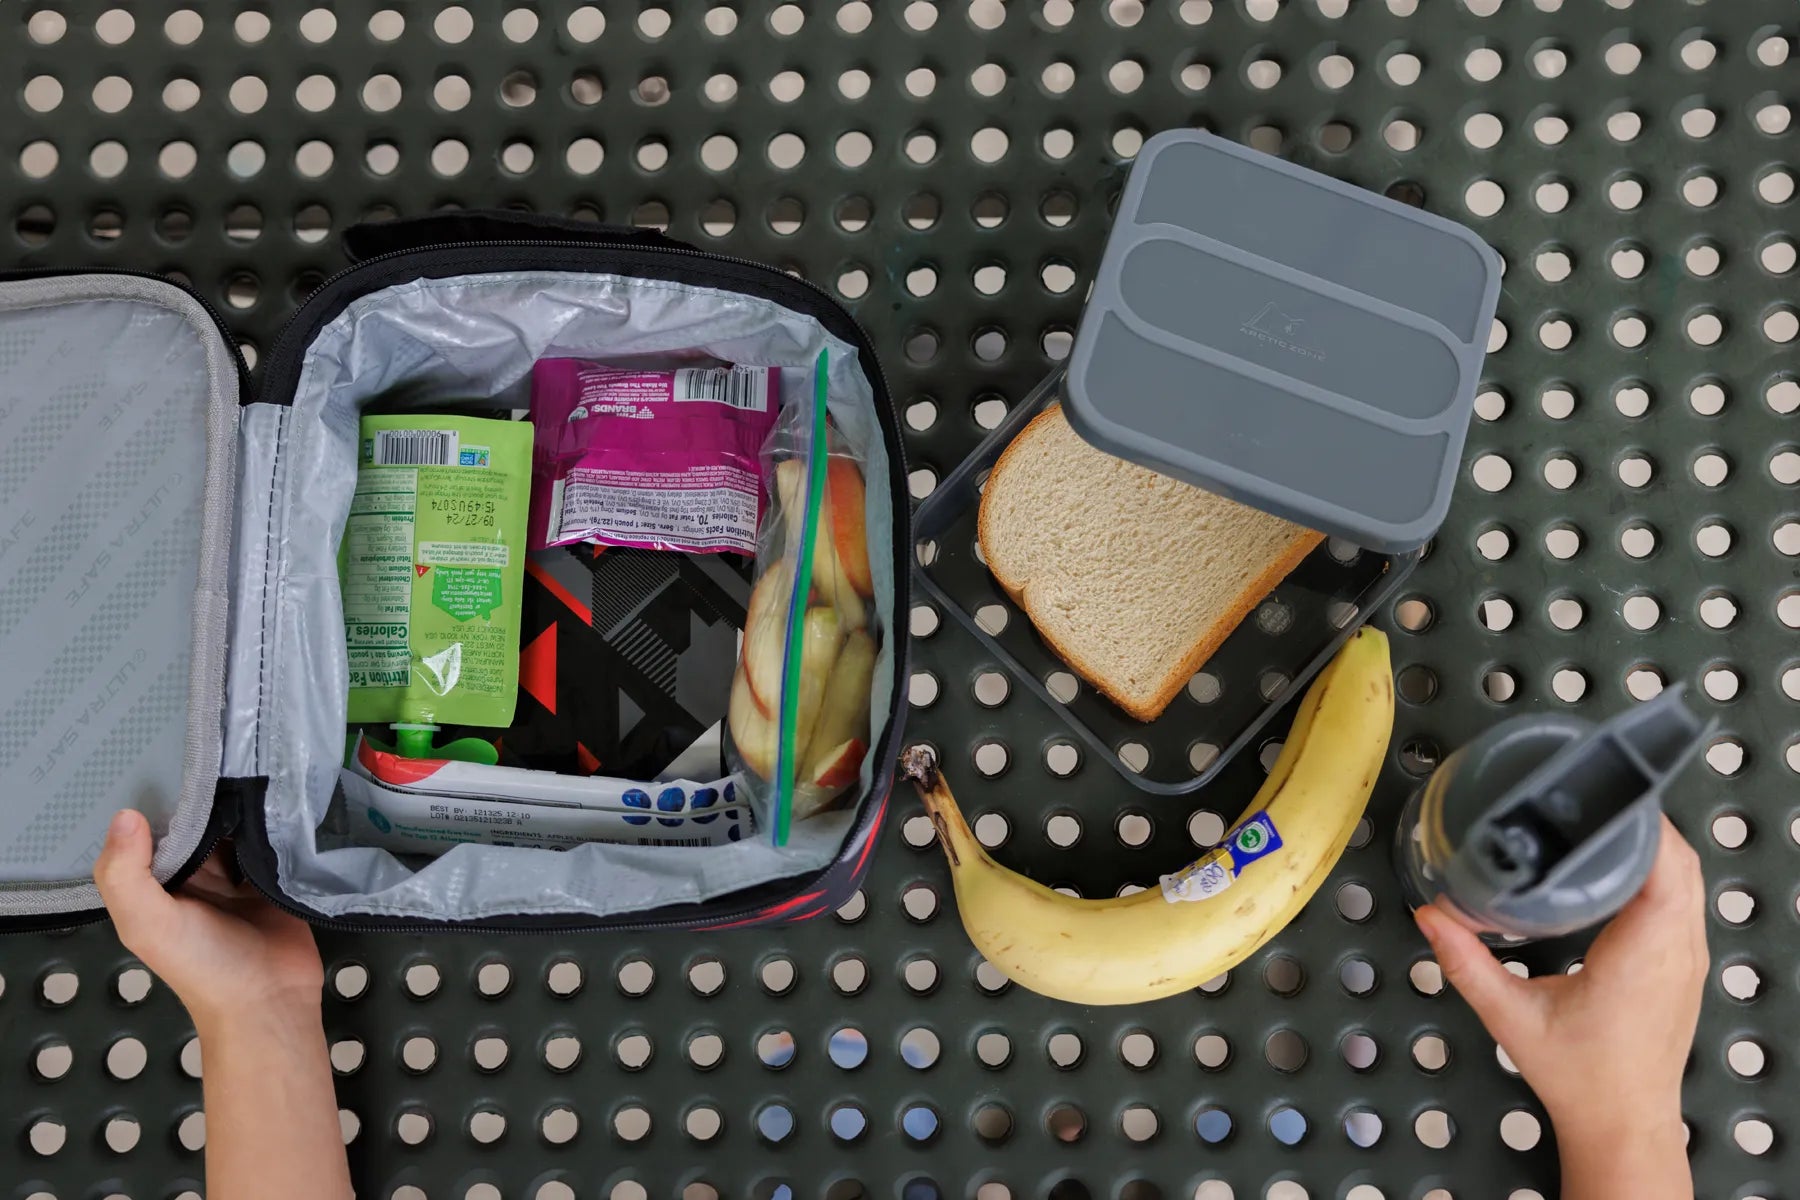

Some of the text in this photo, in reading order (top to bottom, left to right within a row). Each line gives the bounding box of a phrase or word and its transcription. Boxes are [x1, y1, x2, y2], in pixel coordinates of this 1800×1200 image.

[1240, 327, 1286, 348] ARCTIC
[616, 508, 636, 516] Sodium
[712, 514, 738, 522] Calories
[446, 513, 496, 527] 09/27/24
[614, 520, 634, 528] pouch
[640, 522, 656, 530] Size:
[658, 524, 674, 532] Serv.
[706, 526, 724, 534] Facts
[726, 526, 754, 540] Nutrition
[65, 484, 170, 608] ULTRA SAFE
[346, 626, 408, 642] Calories 7
[348, 671, 368, 686] Fac
[28, 661, 137, 785] ULTRA SAFE
[430, 804, 449, 812] BEST
[474, 808, 502, 817] 121325
[430, 812, 450, 820] LOT#
